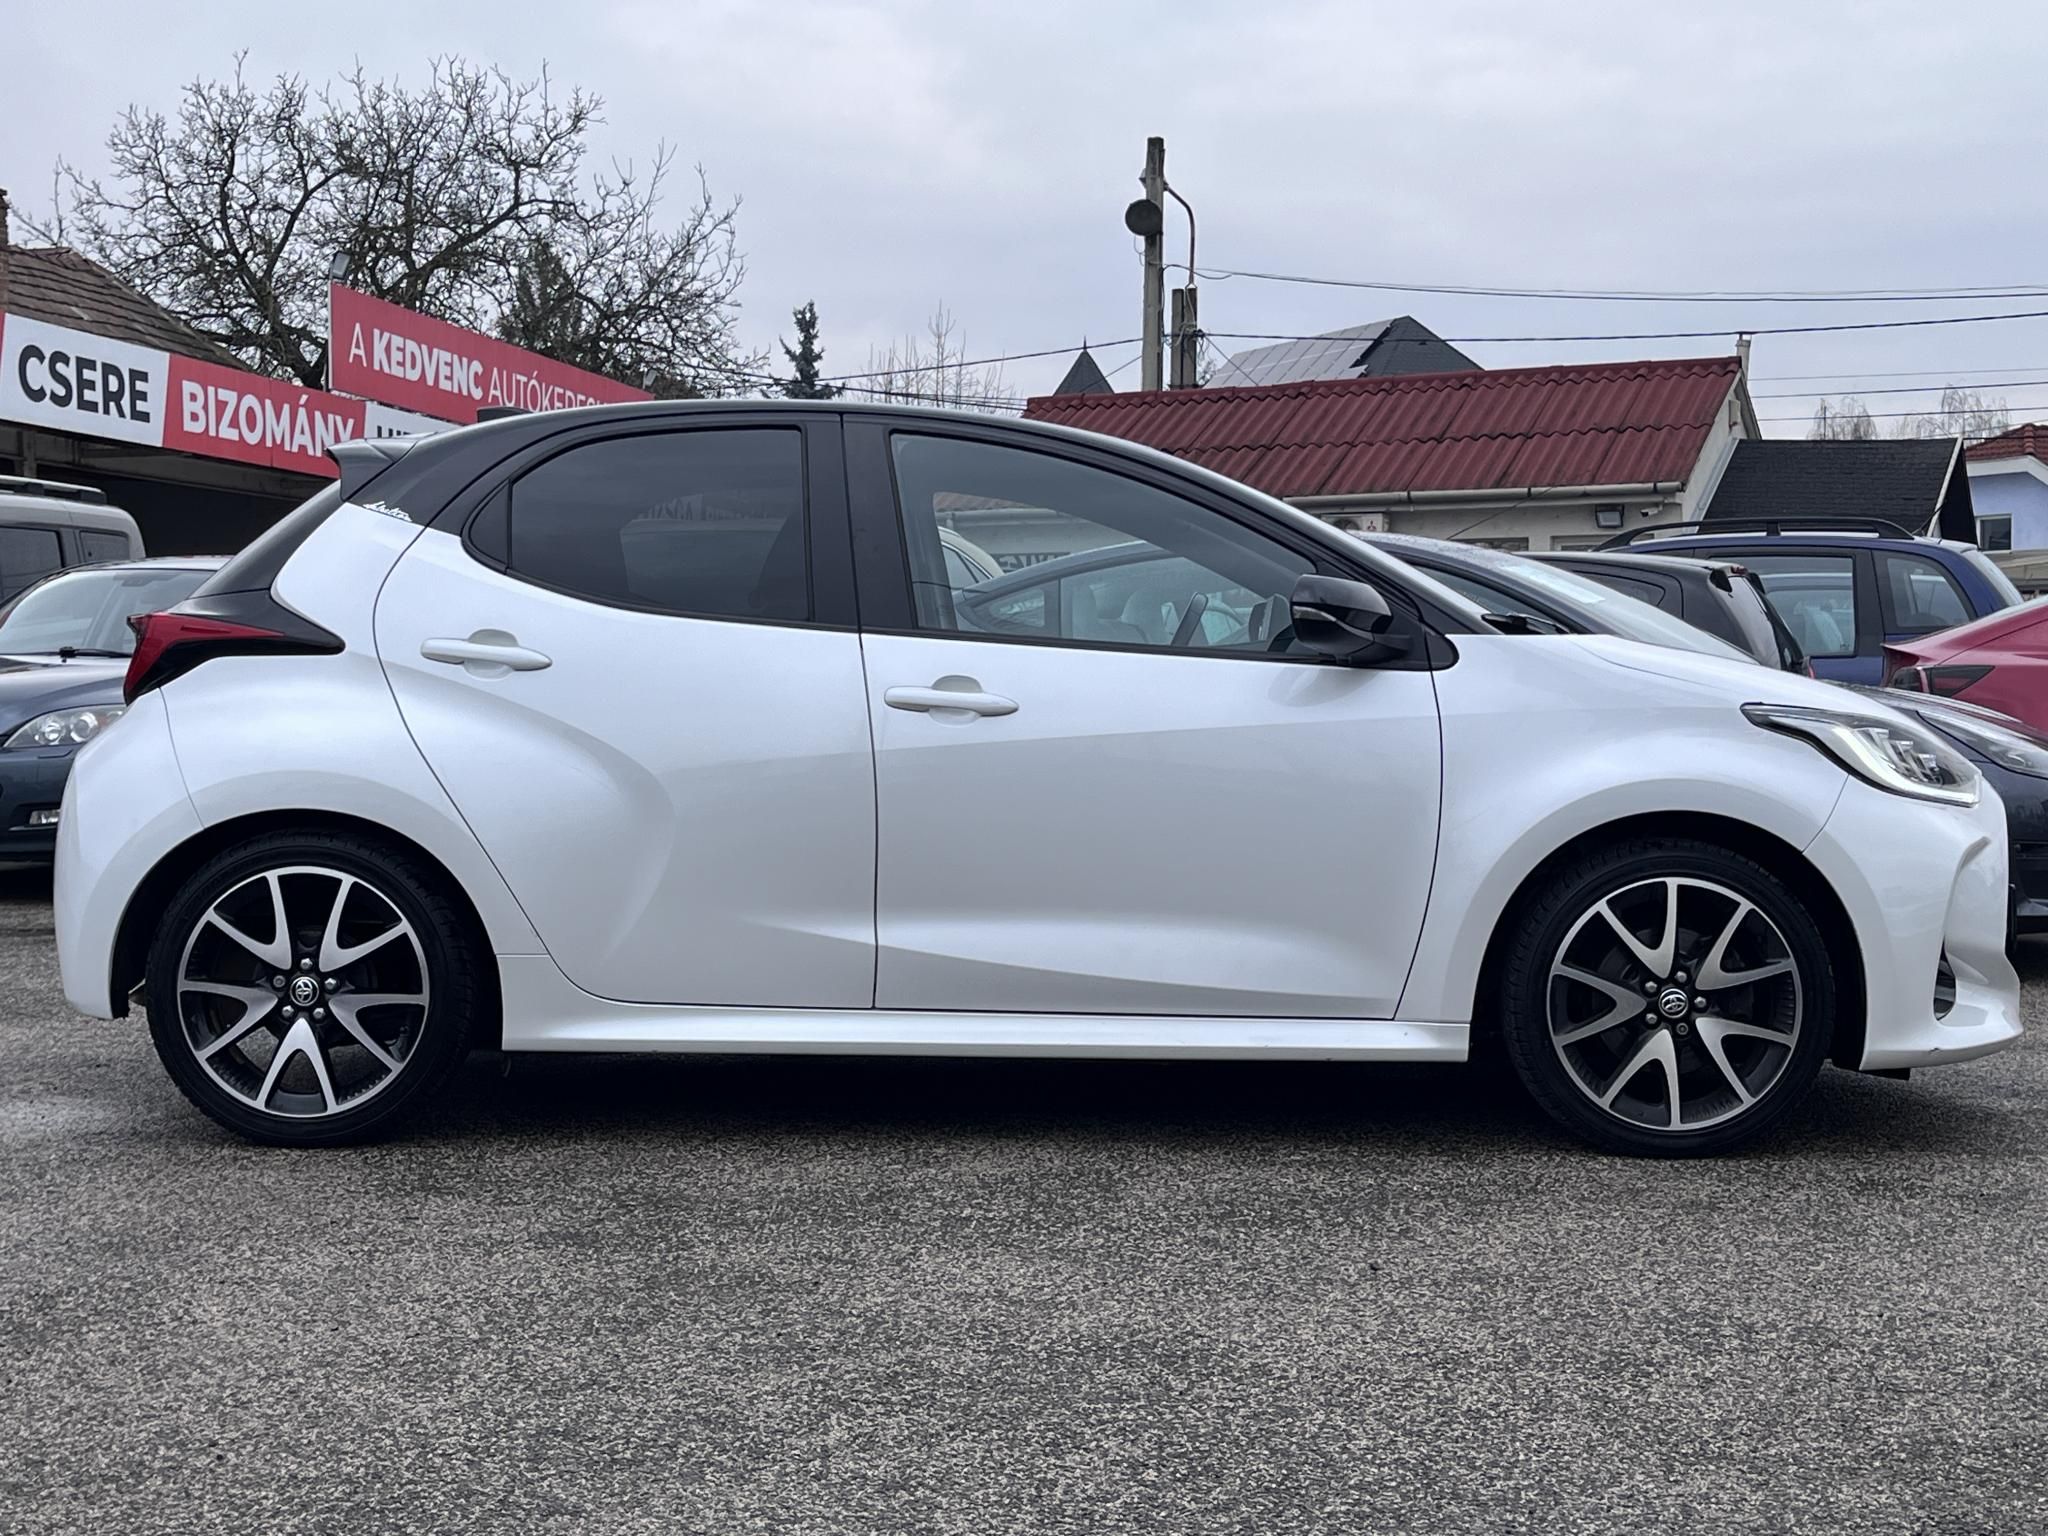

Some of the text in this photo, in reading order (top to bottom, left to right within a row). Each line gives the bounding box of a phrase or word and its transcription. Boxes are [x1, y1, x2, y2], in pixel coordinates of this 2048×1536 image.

[18, 344, 151, 424] CSERE
[348, 322, 368, 368] A
[372, 327, 484, 401] KEDVENC
[181, 379, 355, 458] BIZOMÁNY
